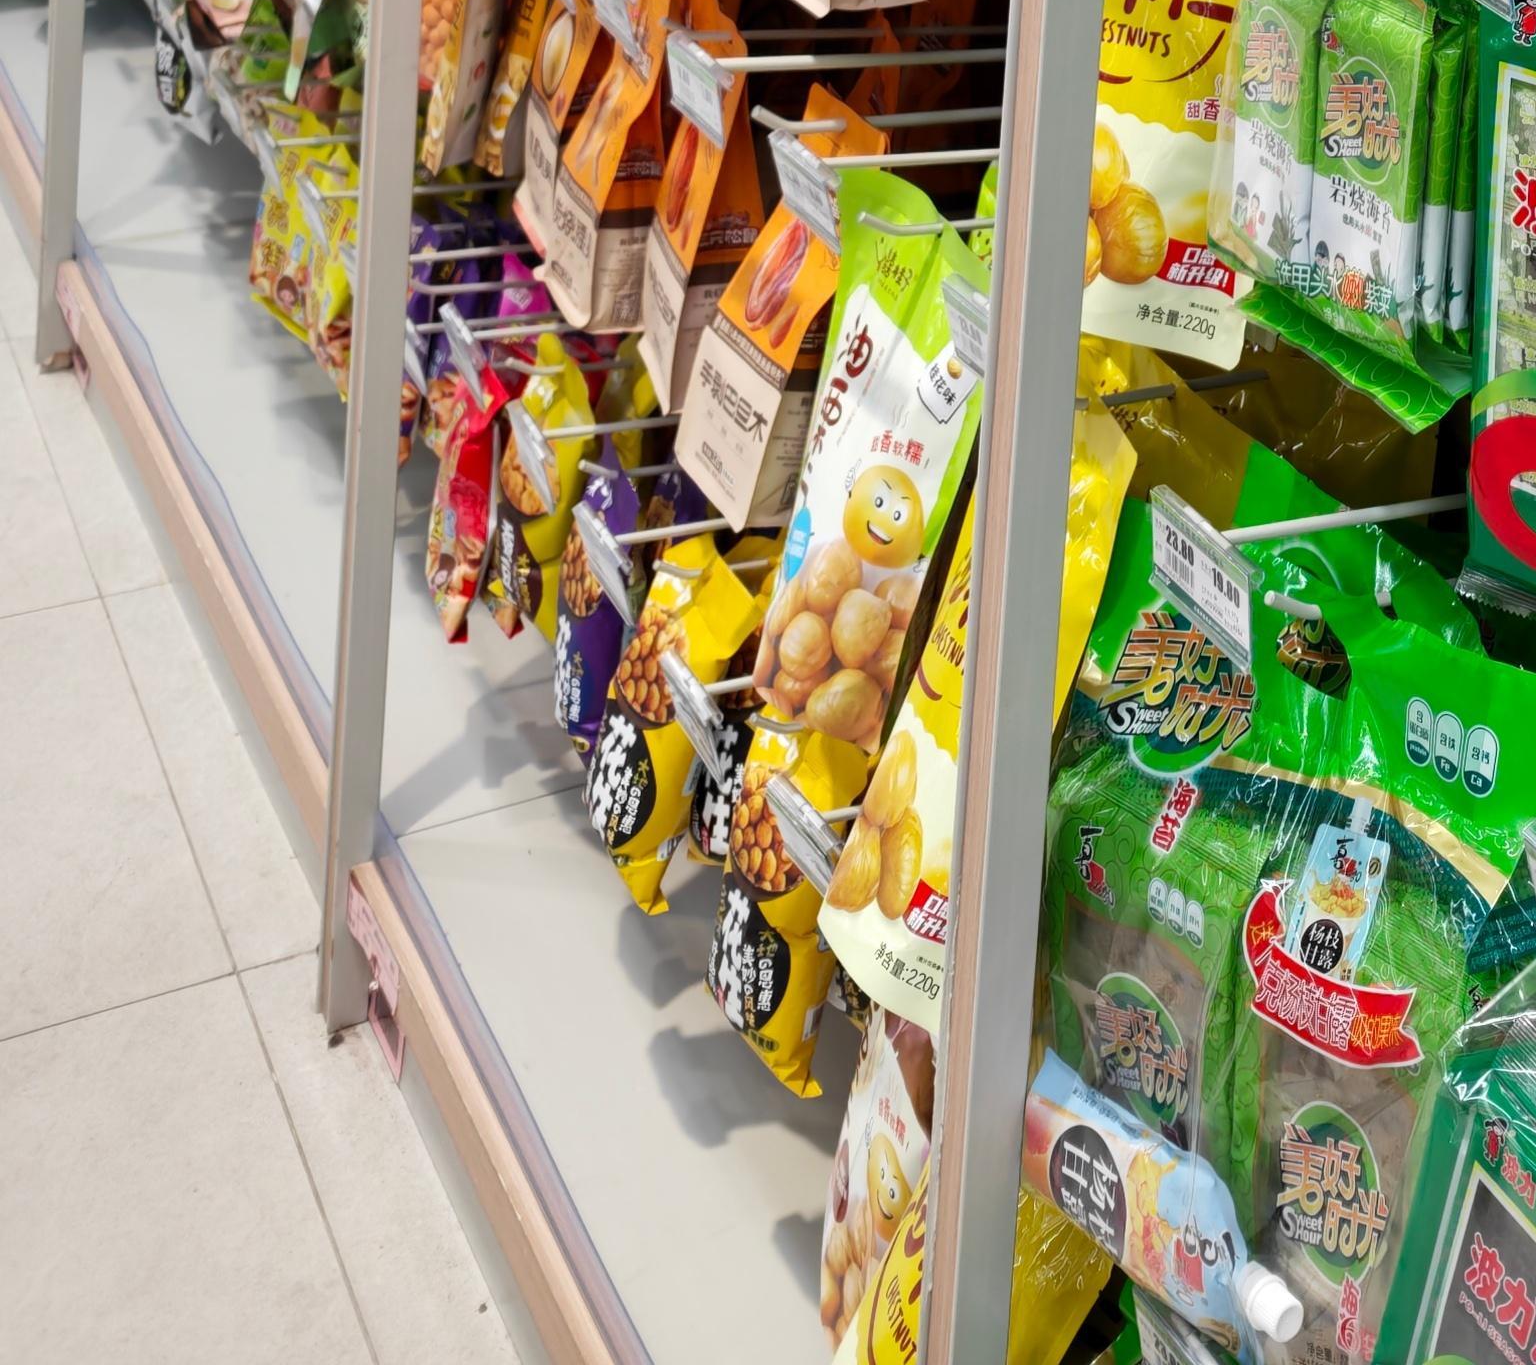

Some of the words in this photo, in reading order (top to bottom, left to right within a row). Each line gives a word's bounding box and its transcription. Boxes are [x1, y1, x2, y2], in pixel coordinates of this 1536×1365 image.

[1329, 173, 1394, 237] 岩烧海苔
[1136, 301, 1217, 341] 净含量:220g
